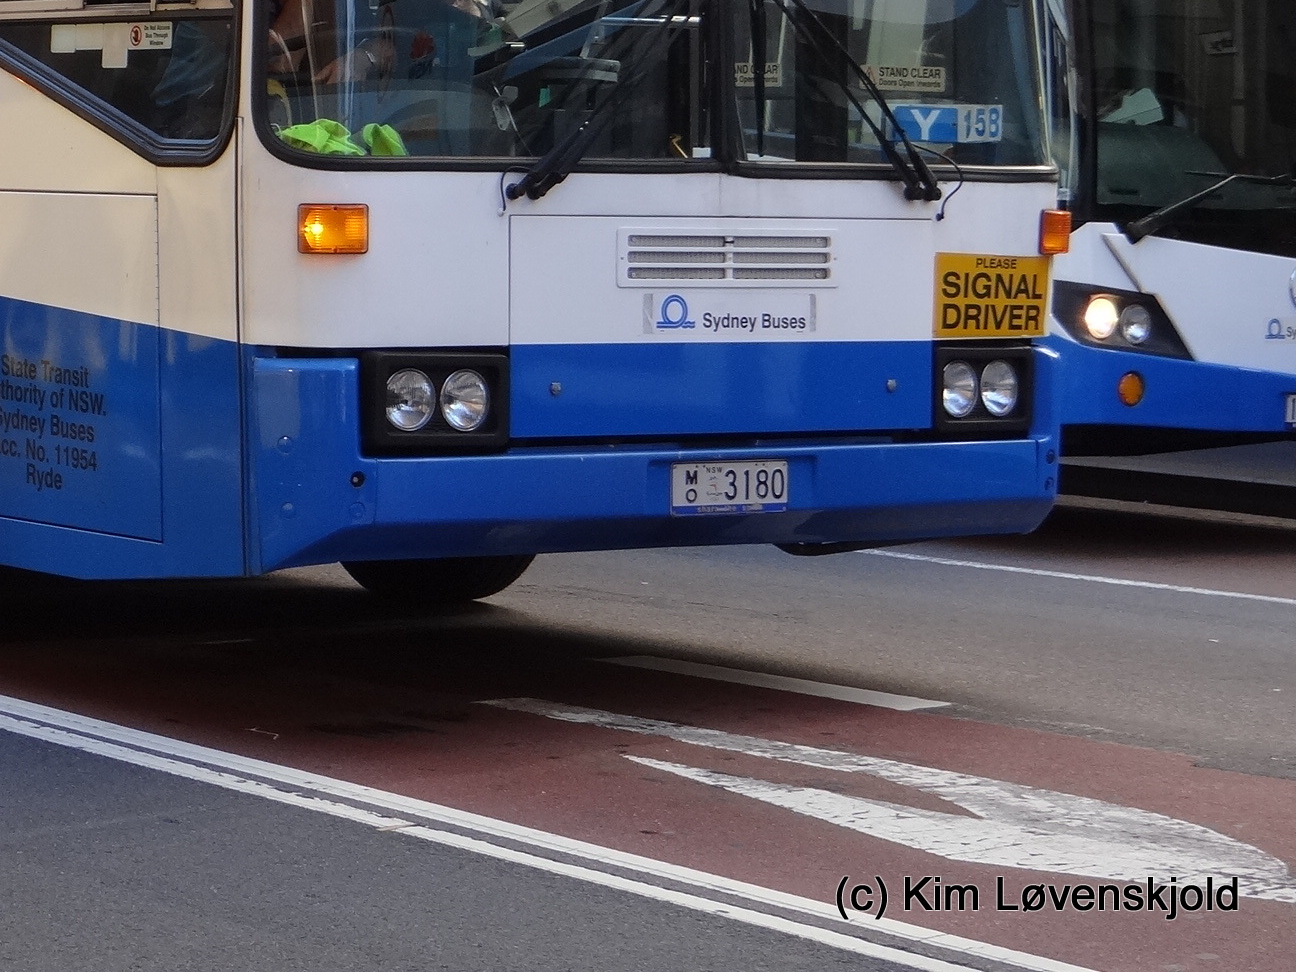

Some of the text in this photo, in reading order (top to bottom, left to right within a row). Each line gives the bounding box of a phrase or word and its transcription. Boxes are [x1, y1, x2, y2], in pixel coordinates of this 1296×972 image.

[878, 66, 942, 80] STAND CLEAR
[878, 78, 898, 86] Doors
[898, 79, 915, 89] Open
[910, 109, 941, 141] Y
[976, 258, 1018, 270] PLEASE
[941, 271, 1043, 300] SIGNAL
[702, 312, 807, 333] Sydney Buses
[941, 303, 1041, 331] DRIVER
[0, 354, 90, 389] State Transit
[50, 388, 65, 409] of
[68, 389, 107, 416] NSW.
[50, 414, 95, 443] Buses
[25, 438, 50, 463] No.
[55, 444, 98, 471] 11954
[26, 463, 63, 492] Ryde
[685, 470, 698, 485] M
[706, 466, 723, 474] NSW
[724, 468, 785, 501] 3180
